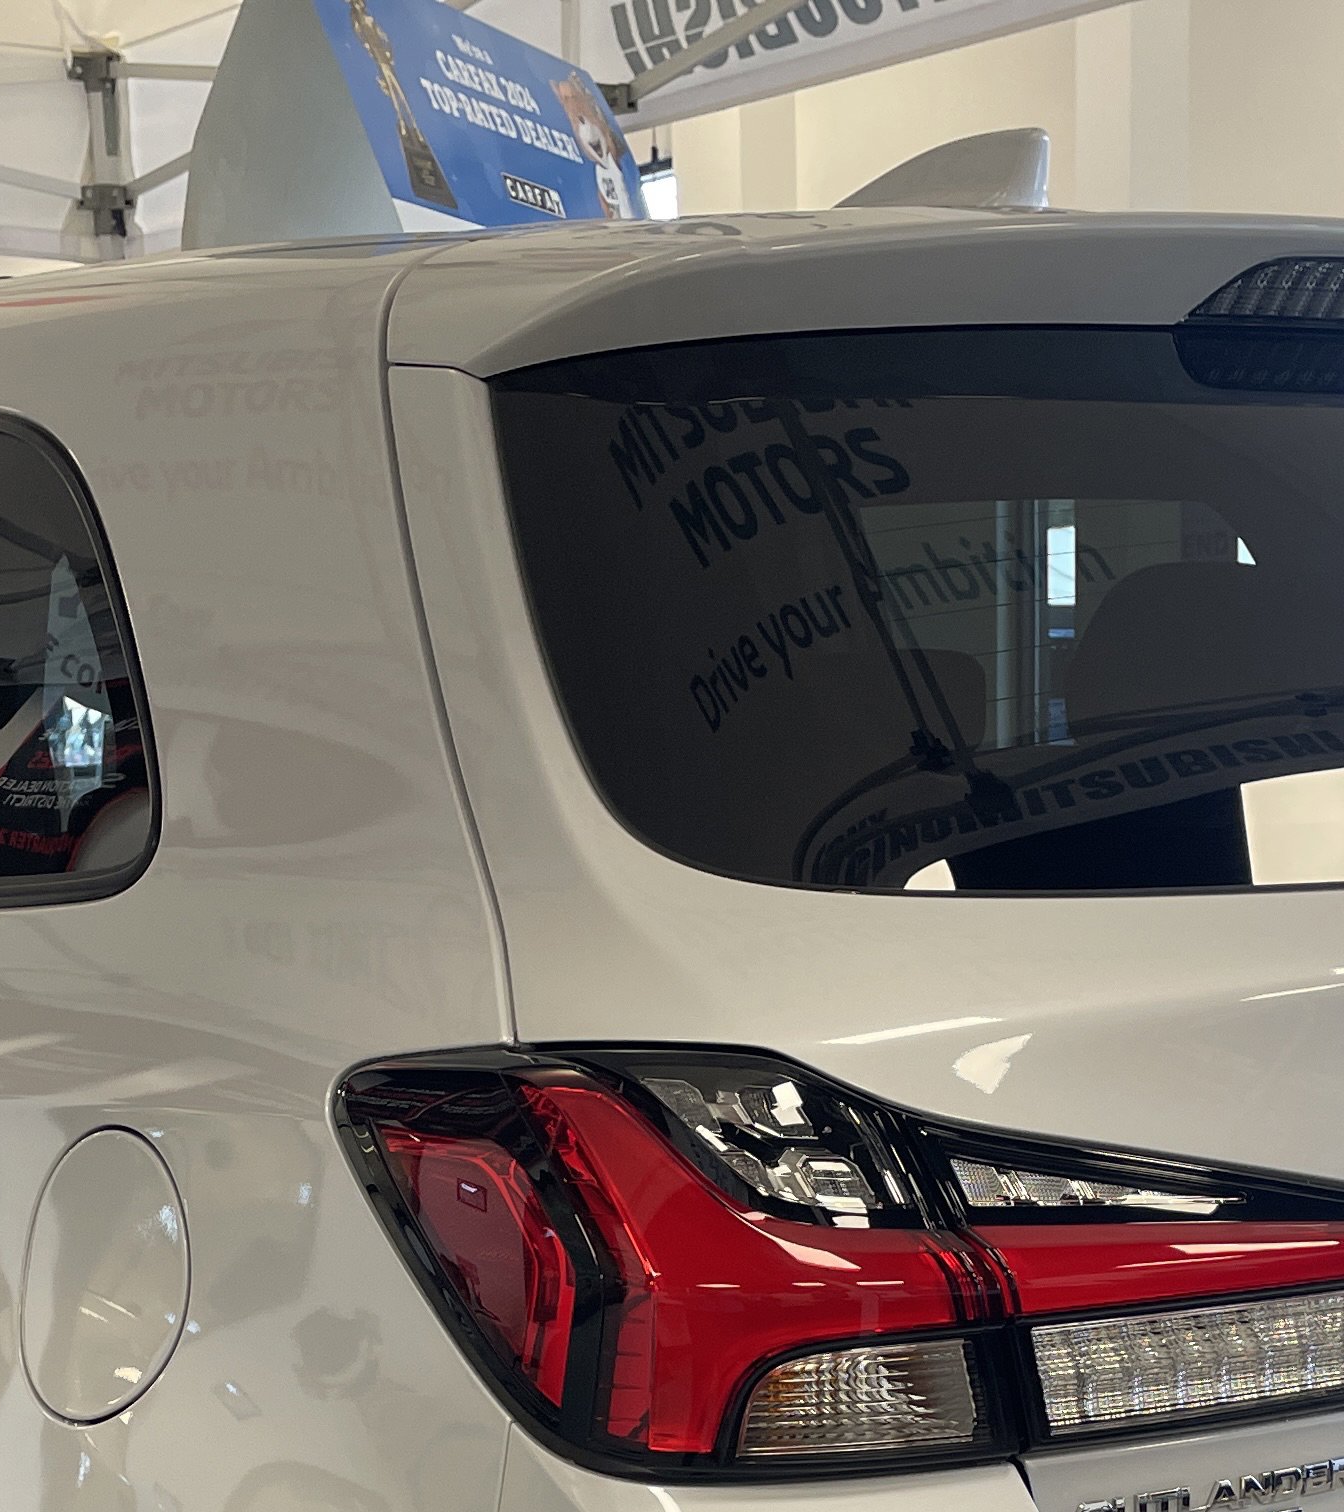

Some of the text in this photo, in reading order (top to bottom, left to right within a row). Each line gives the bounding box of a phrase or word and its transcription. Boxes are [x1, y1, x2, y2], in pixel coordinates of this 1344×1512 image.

[419, 77, 584, 164] TOP-RATED DEALER!
[435, 50, 541, 115] CARFAX 2024
[667, 427, 912, 568] MOTORS
[756, 584, 851, 681] your
[855, 535, 1117, 611] Ambitin
